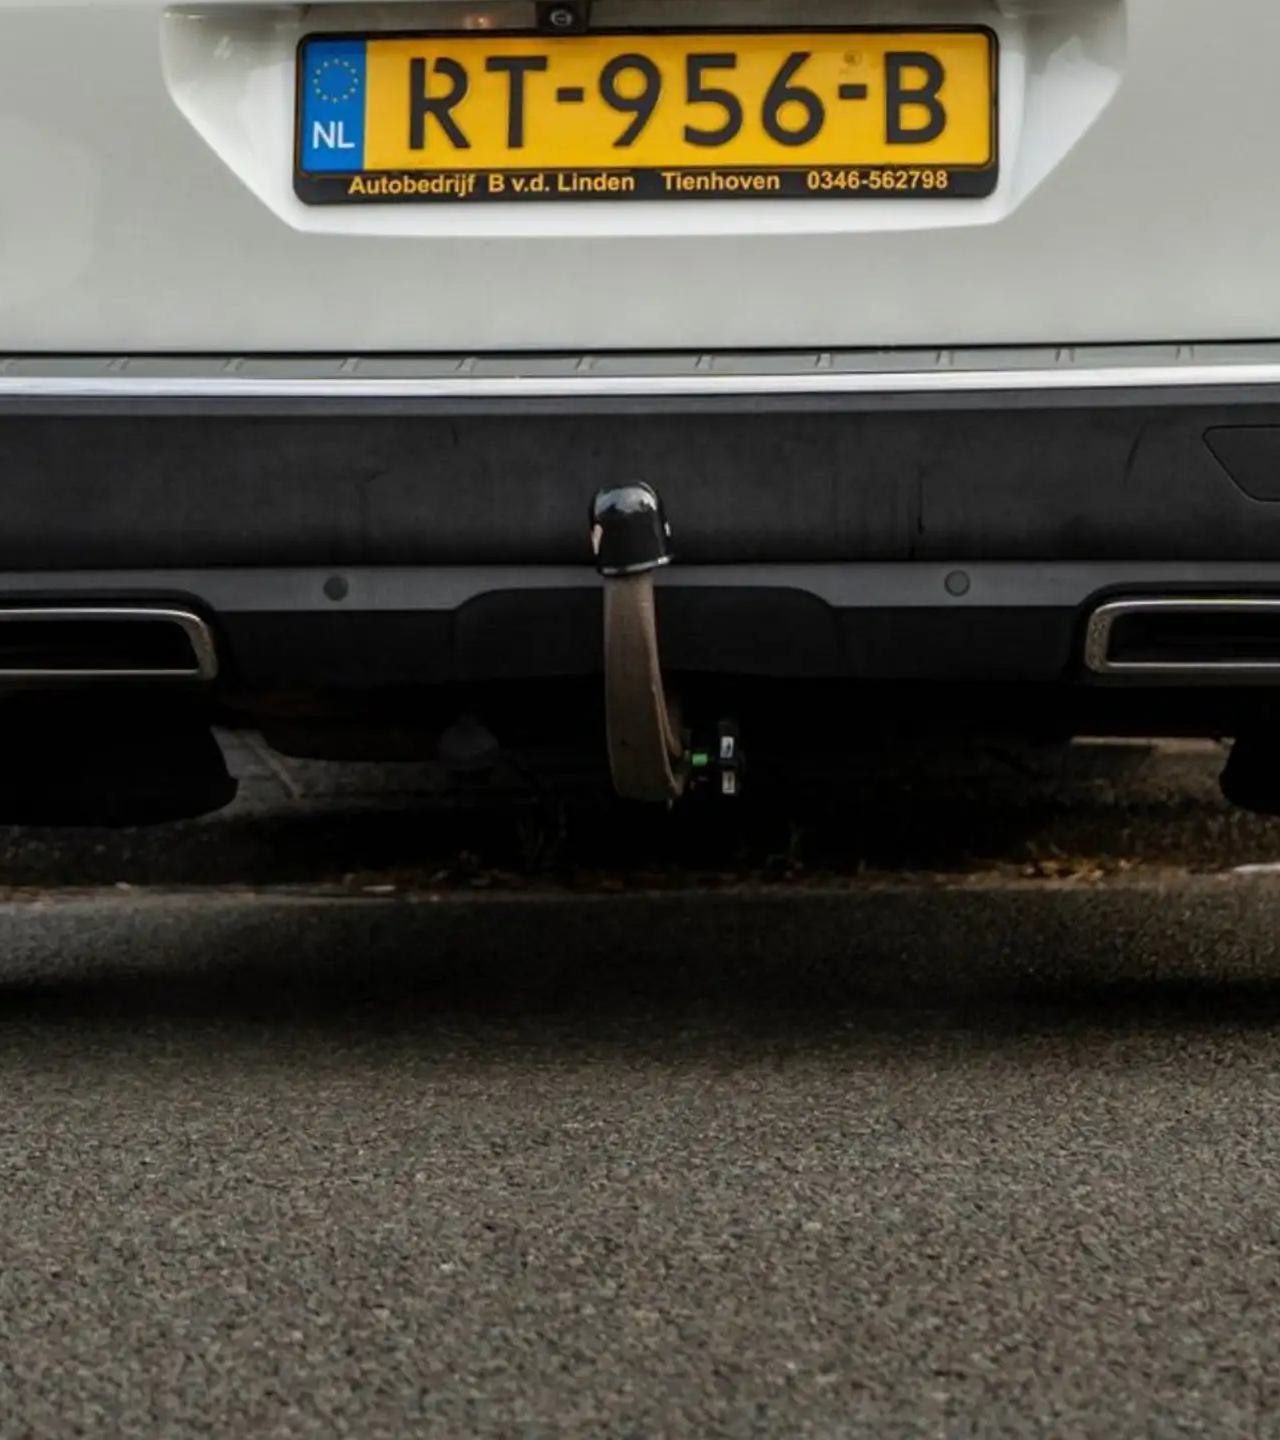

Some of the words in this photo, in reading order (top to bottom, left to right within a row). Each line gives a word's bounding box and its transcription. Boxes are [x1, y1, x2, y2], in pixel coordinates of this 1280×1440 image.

[409, 51, 947, 150] RT-956-B
[312, 121, 355, 149] NL
[348, 173, 476, 197] Autobedrijf
[488, 173, 505, 193] B
[511, 171, 550, 193] v.d.
[557, 171, 635, 192] Linden
[661, 170, 781, 191] Tienhoven
[806, 168, 949, 190] 0346-562798
